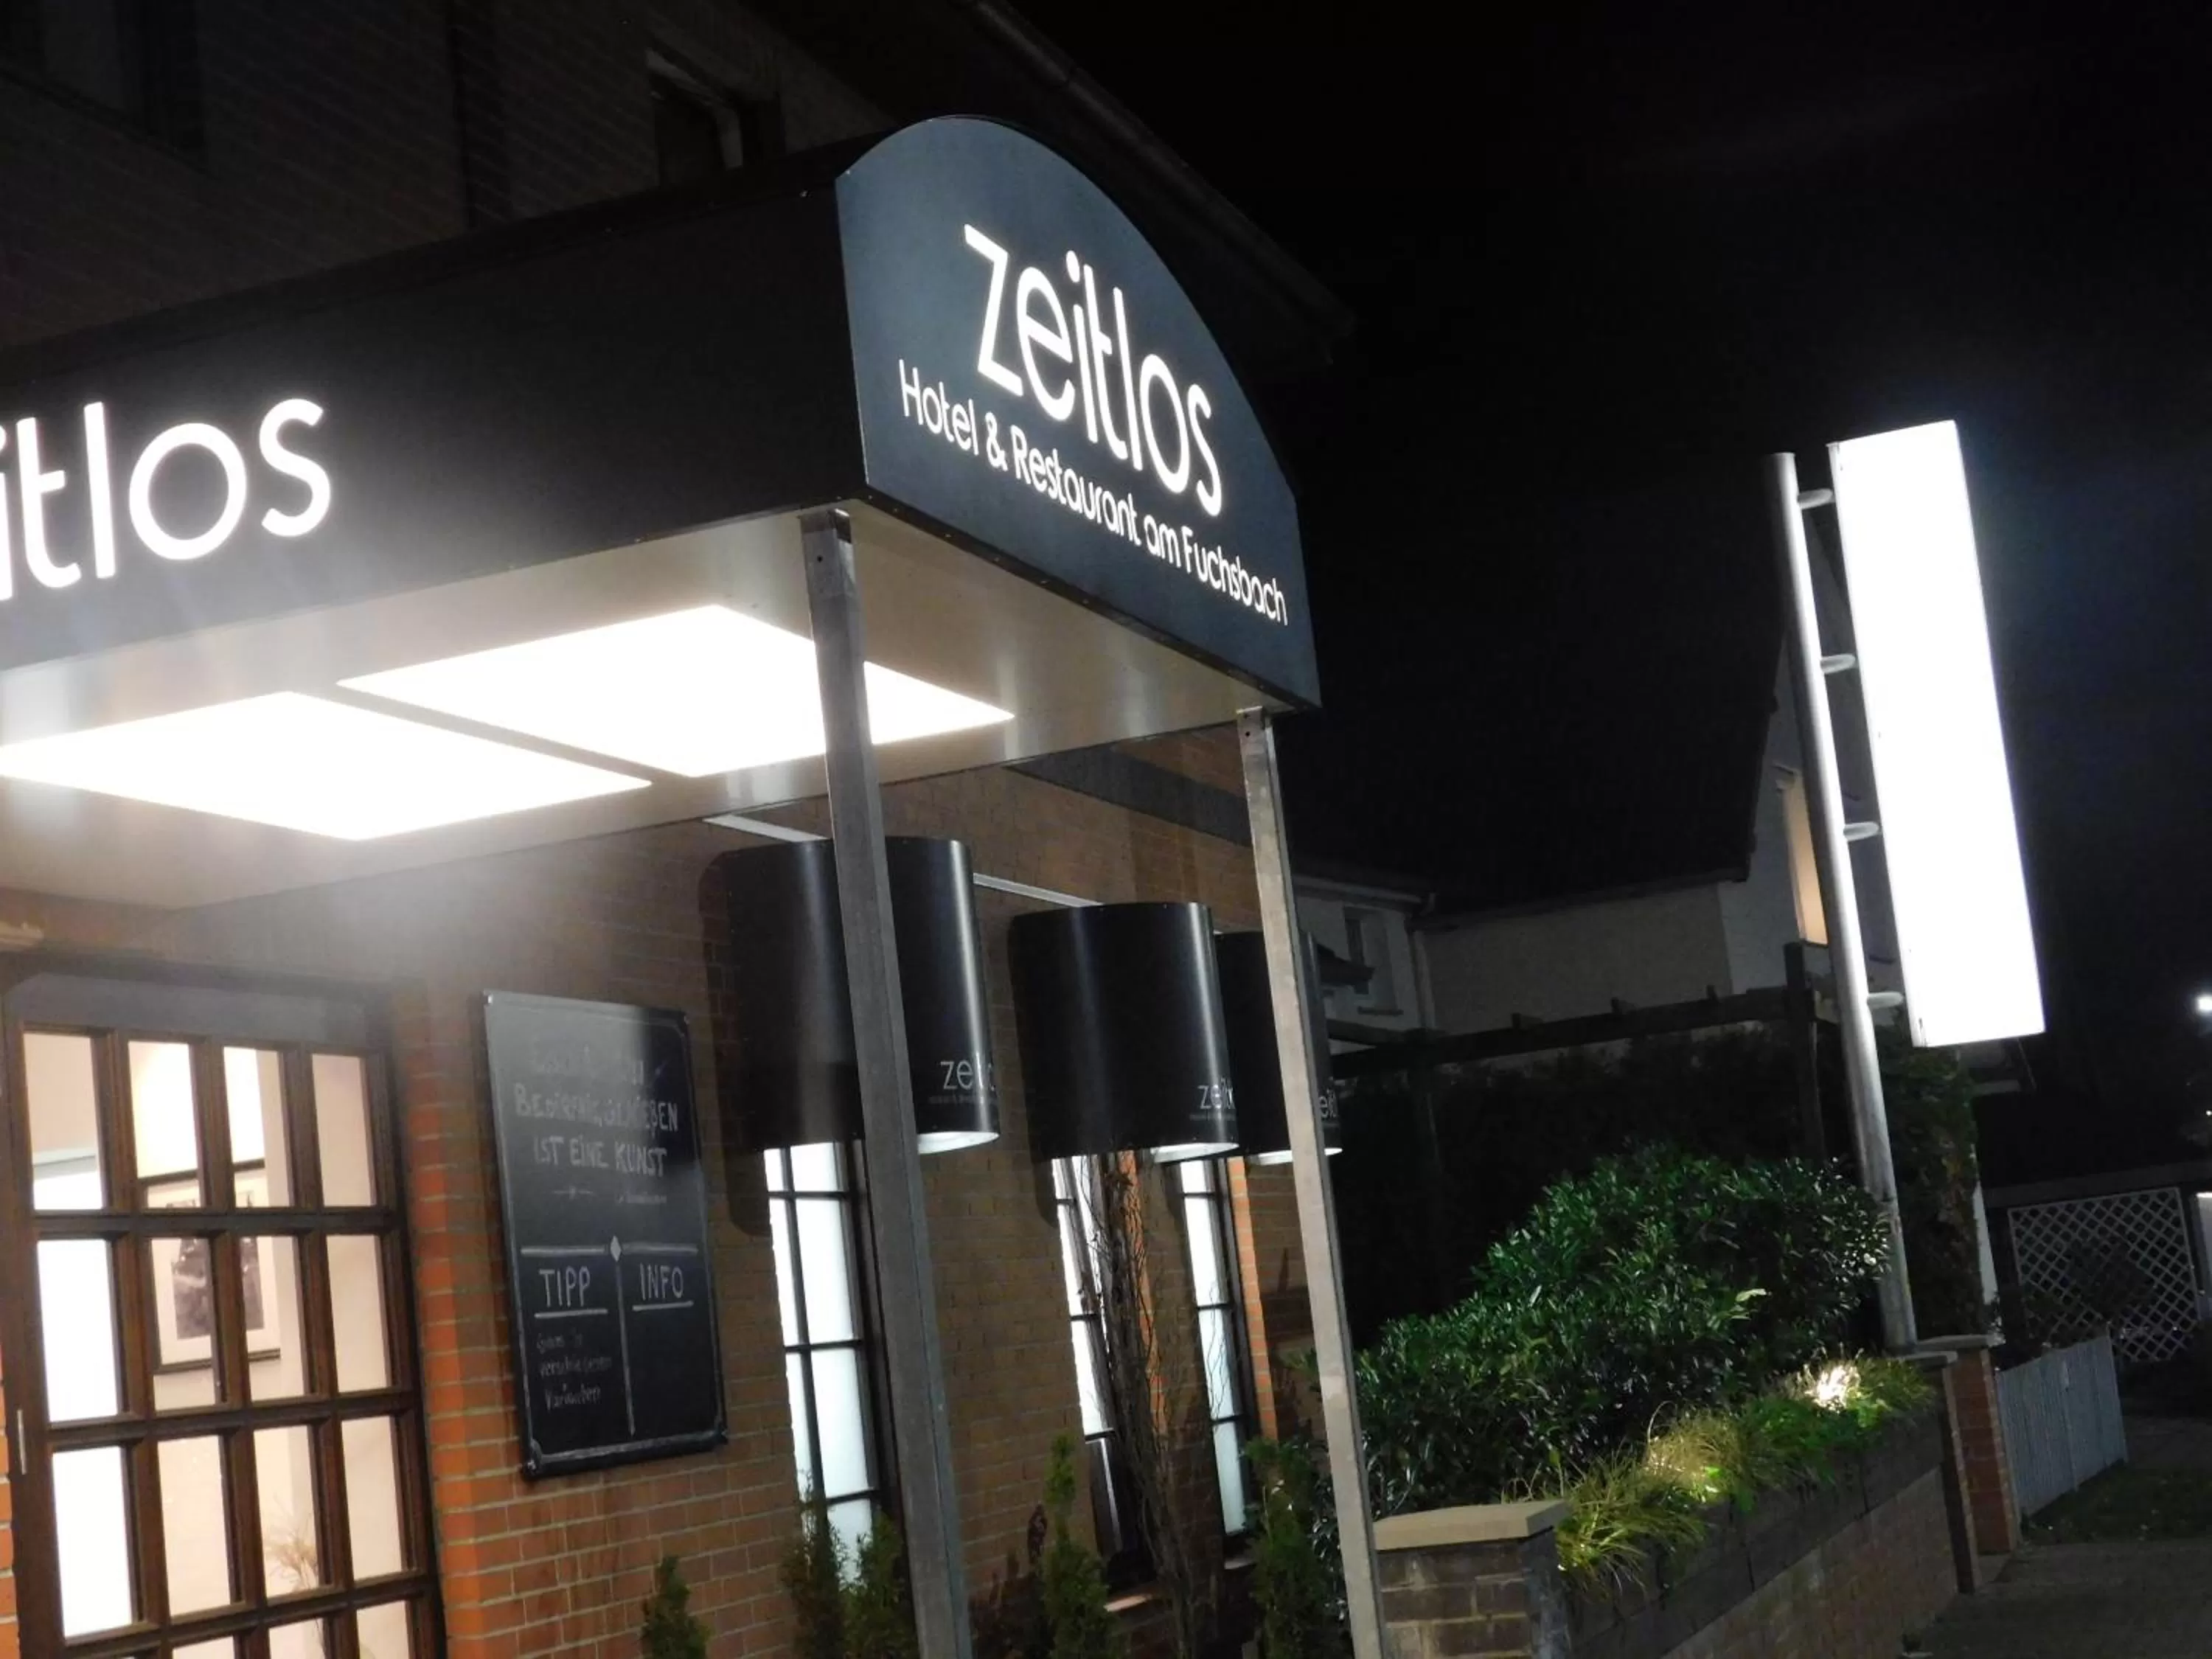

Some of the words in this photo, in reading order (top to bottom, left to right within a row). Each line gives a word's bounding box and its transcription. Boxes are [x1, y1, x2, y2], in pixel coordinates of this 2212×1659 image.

[898, 358, 980, 457] Hotel
[984, 411, 1009, 472] &
[1009, 424, 1142, 546] Restaurant
[1143, 513, 1182, 568] am
[1180, 525, 1289, 627] Fuchsbach
[613, 1138, 668, 1178] KUNST
[538, 1265, 591, 1308] TIPP
[639, 1262, 684, 1301] INFO
